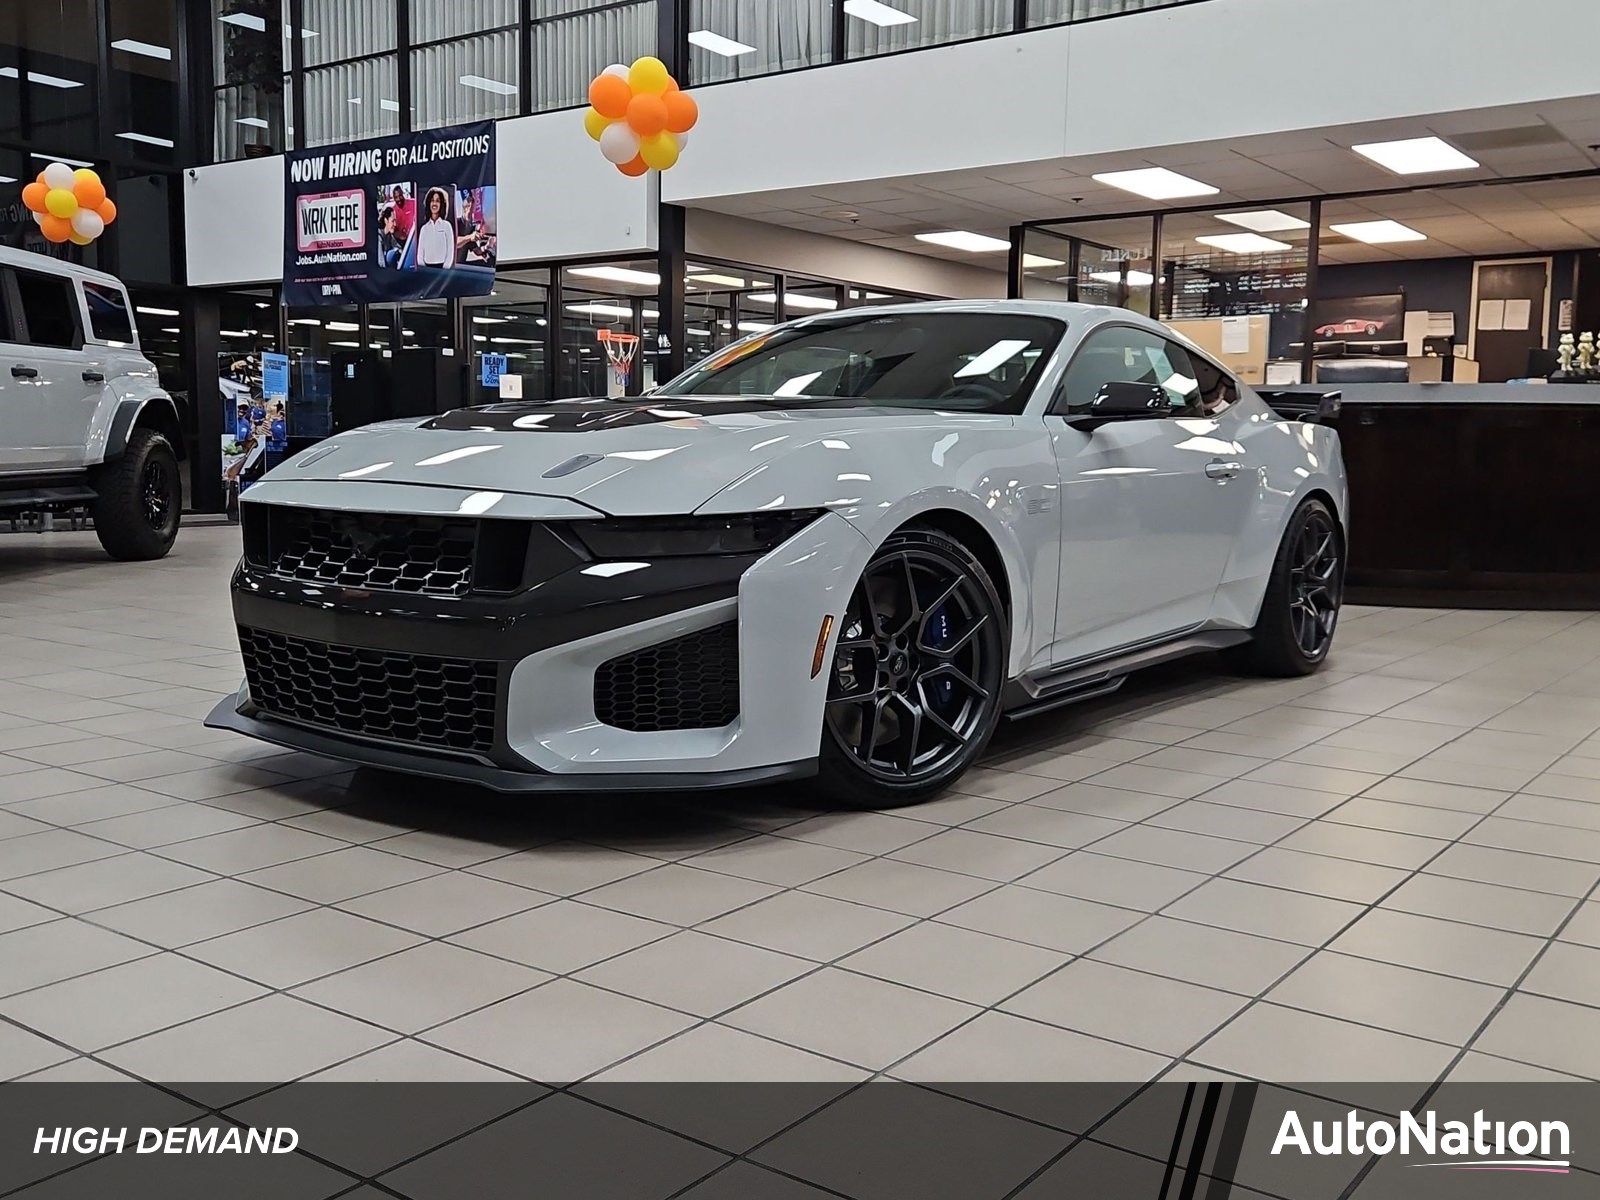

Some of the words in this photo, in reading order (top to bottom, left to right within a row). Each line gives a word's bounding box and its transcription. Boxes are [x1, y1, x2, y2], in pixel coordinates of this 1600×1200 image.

[291, 156, 325, 183] NOW
[328, 148, 382, 179] HIRING
[386, 147, 408, 167] FOR
[409, 144, 429, 164] ALL
[431, 134, 490, 161] POSITIONS
[301, 207, 328, 236] WRK
[330, 203, 359, 233] HERE
[295, 251, 367, 266] Jobs.AutoNation.com
[484, 356, 505, 366] READY
[488, 365, 501, 375] SET
